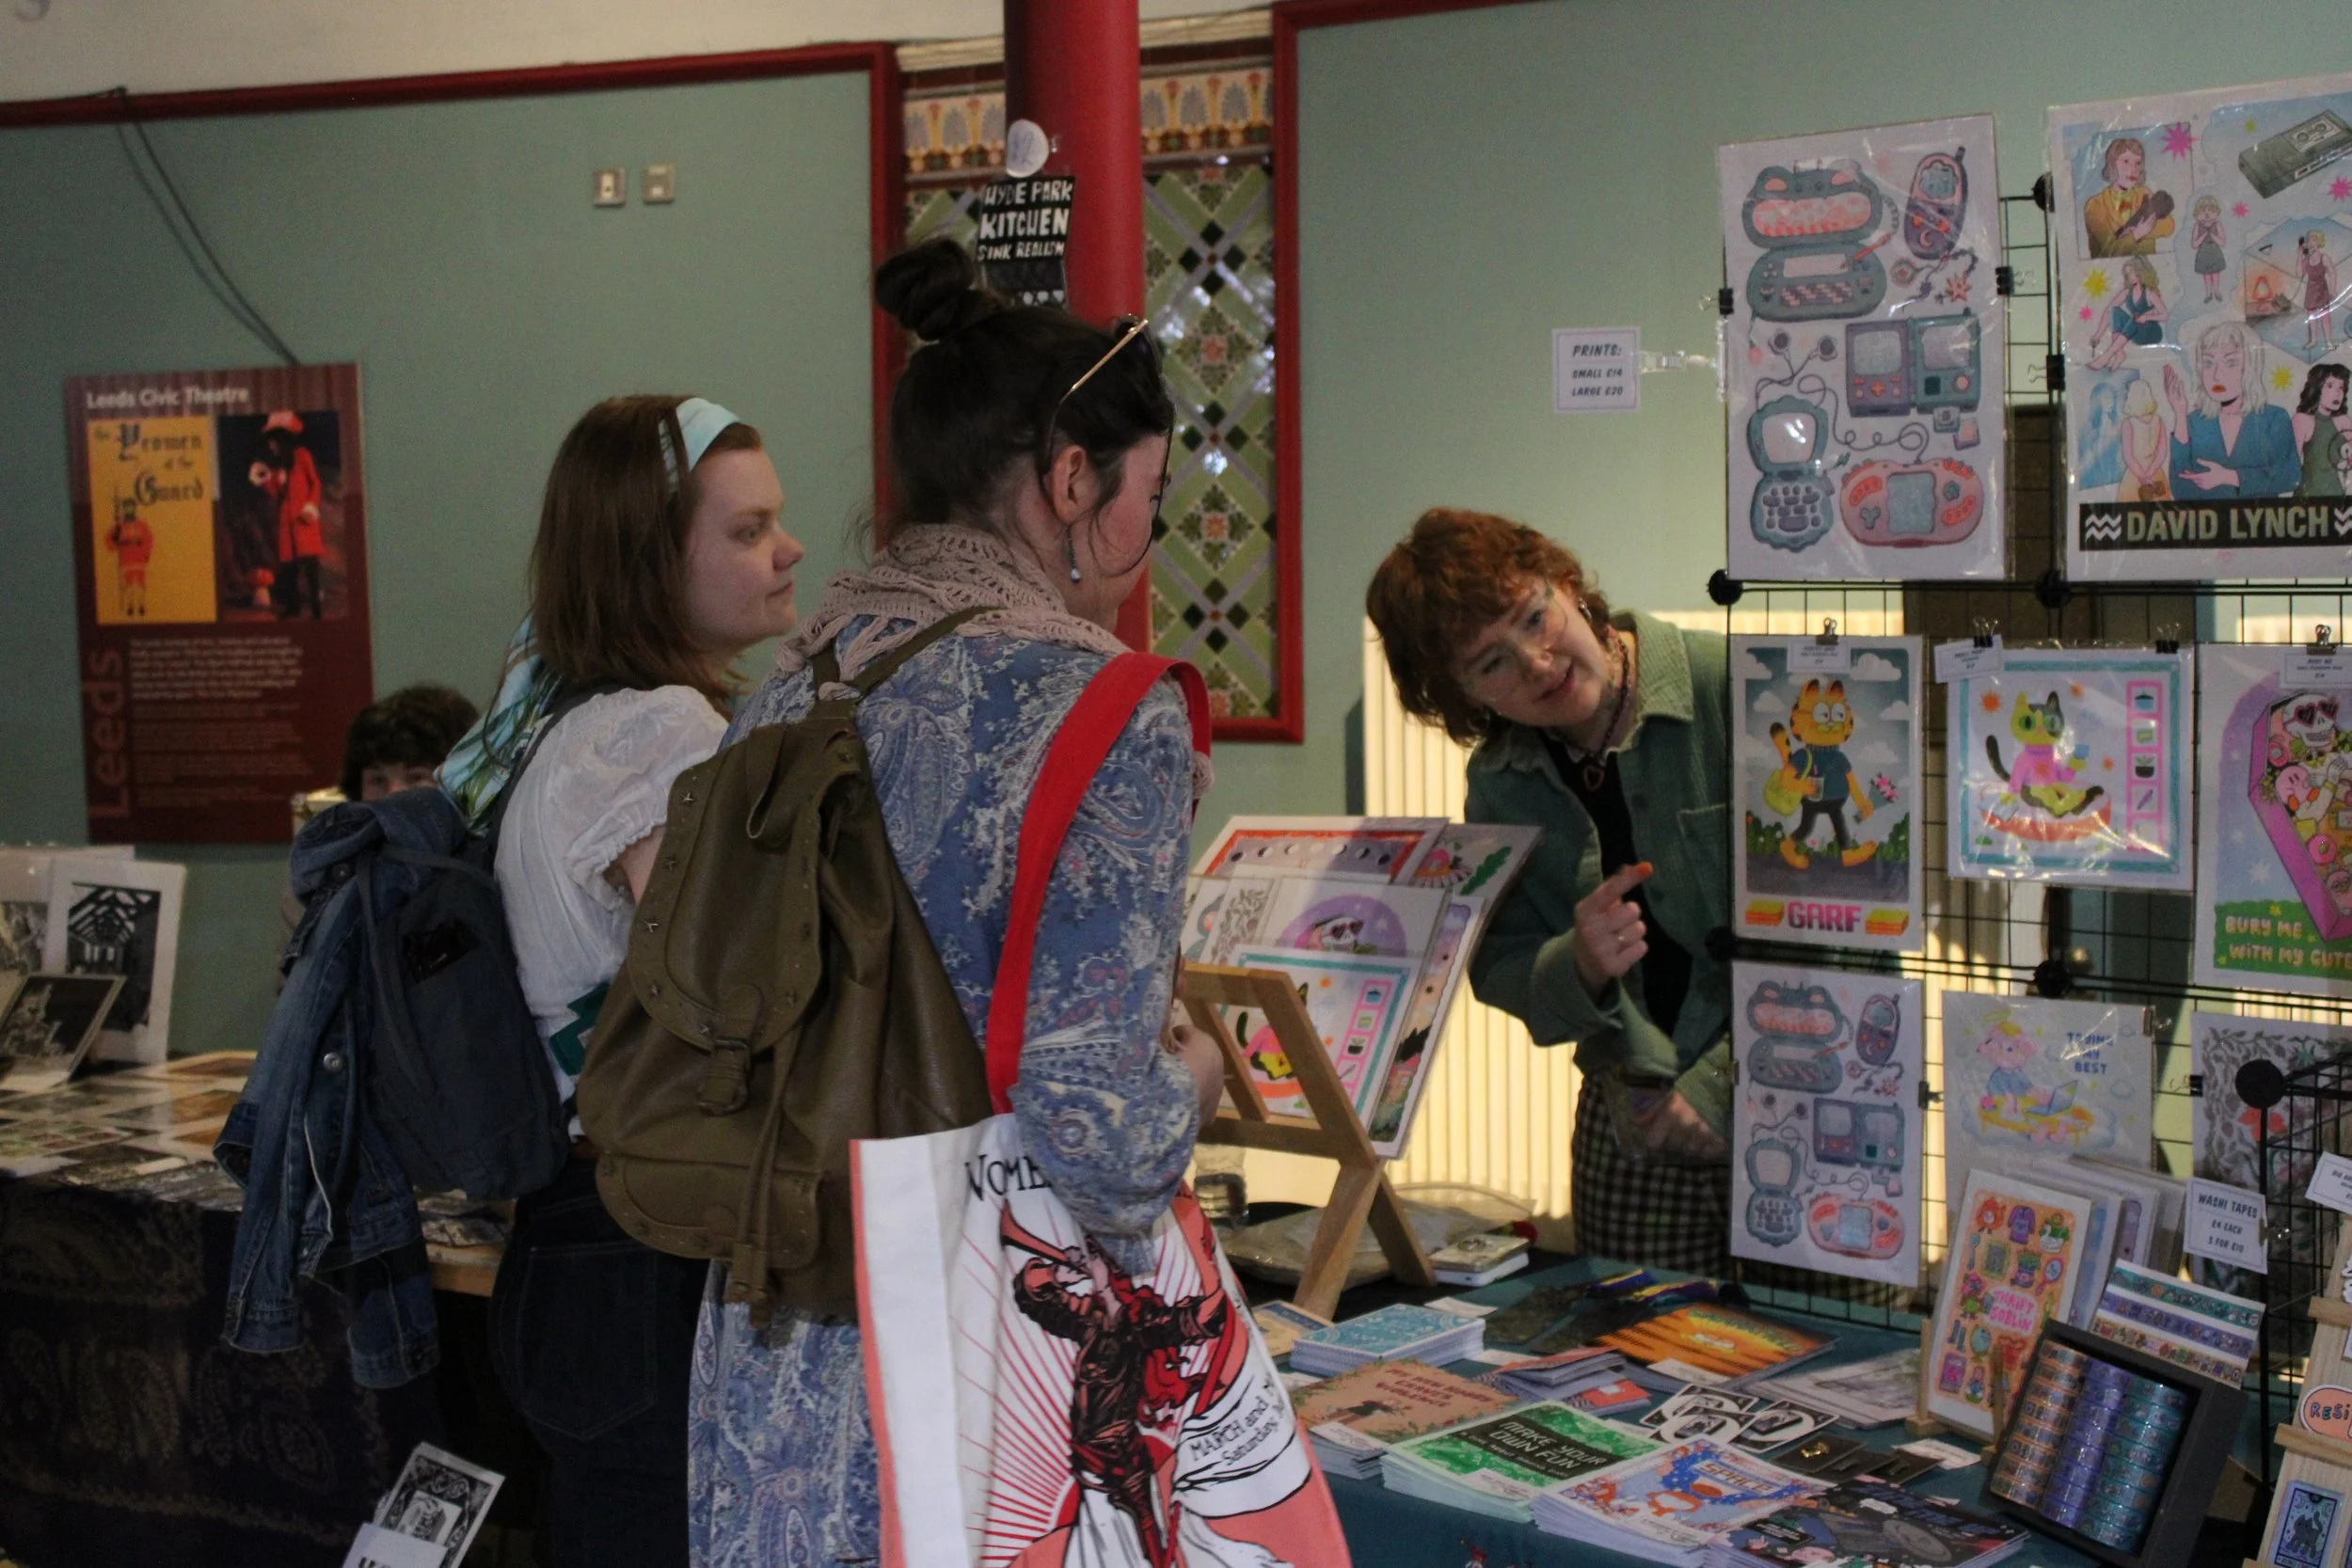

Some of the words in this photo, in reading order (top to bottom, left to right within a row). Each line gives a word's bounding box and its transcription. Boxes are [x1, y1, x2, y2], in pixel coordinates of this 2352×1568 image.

[984, 182, 1027, 206] HYDE
[1031, 180, 1073, 202] PARK
[979, 208, 1070, 240] KITCHEN
[977, 244, 1012, 261] SINK
[1572, 368, 1602, 379] SMALL
[86, 390, 137, 408] Leeds
[184, 384, 251, 404] Theatre
[1572, 387, 1602, 397] LARGE
[2126, 509, 2218, 542] DAVID
[2229, 505, 2328, 539] LYNCH
[1788, 900, 1862, 933] GARF
[2225, 916, 2271, 938] BURY
[2277, 921, 2303, 939] ME
[2279, 947, 2303, 968] MY
[2074, 1061, 2106, 1075] BEST
[2199, 1194, 2228, 1211] WASHI
[2232, 1201, 2257, 1219] TAPES
[2224, 1223, 2243, 1235] EACH
[1189, 1419, 1246, 1463] MARCH
[1245, 1395, 1270, 1428] and
[1489, 1430, 1541, 1453] OWN
[1534, 1449, 1582, 1469] FUN
[1499, 1421, 1557, 1448] MAKE
[1552, 1444, 1608, 1465] YOUR
